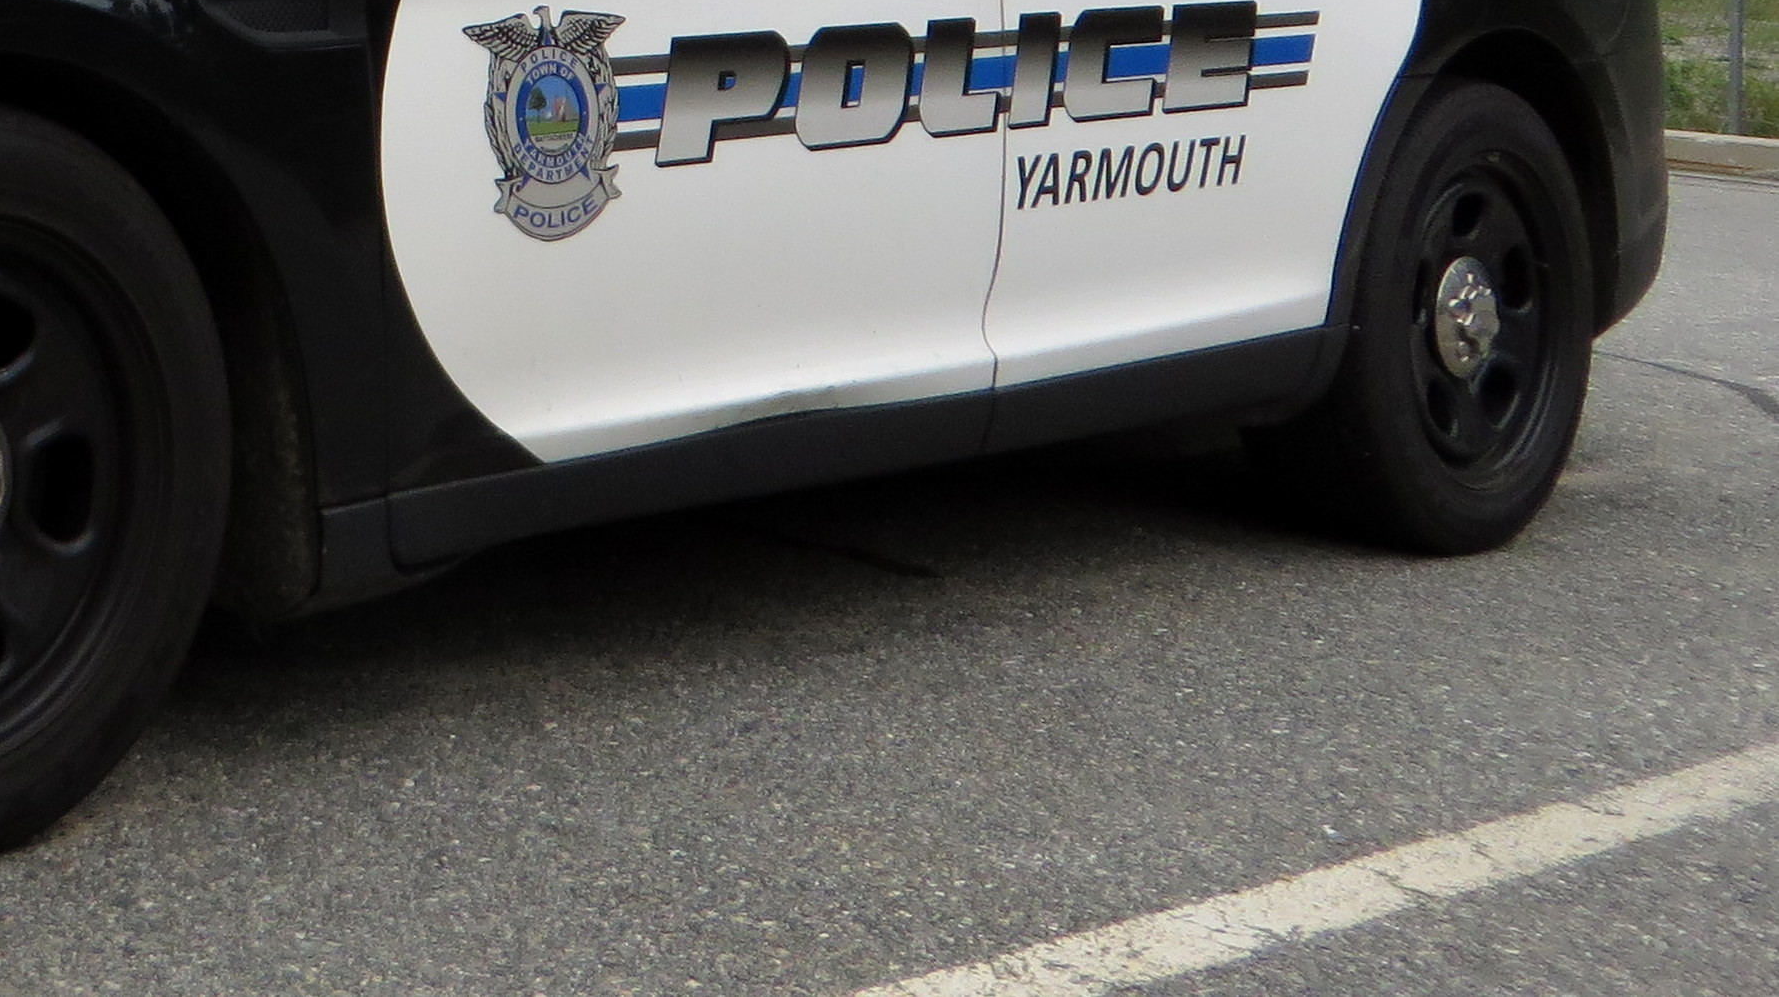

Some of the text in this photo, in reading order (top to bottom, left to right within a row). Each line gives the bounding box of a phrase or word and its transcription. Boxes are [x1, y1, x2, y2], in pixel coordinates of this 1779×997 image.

[520, 49, 579, 74] POLICE
[526, 63, 576, 85] TOWN OF
[654, 0, 1259, 168] POLICE
[513, 135, 595, 184] DEPARTMENT
[1016, 134, 1248, 211] YARMOUTH
[513, 194, 599, 230] POLICE
